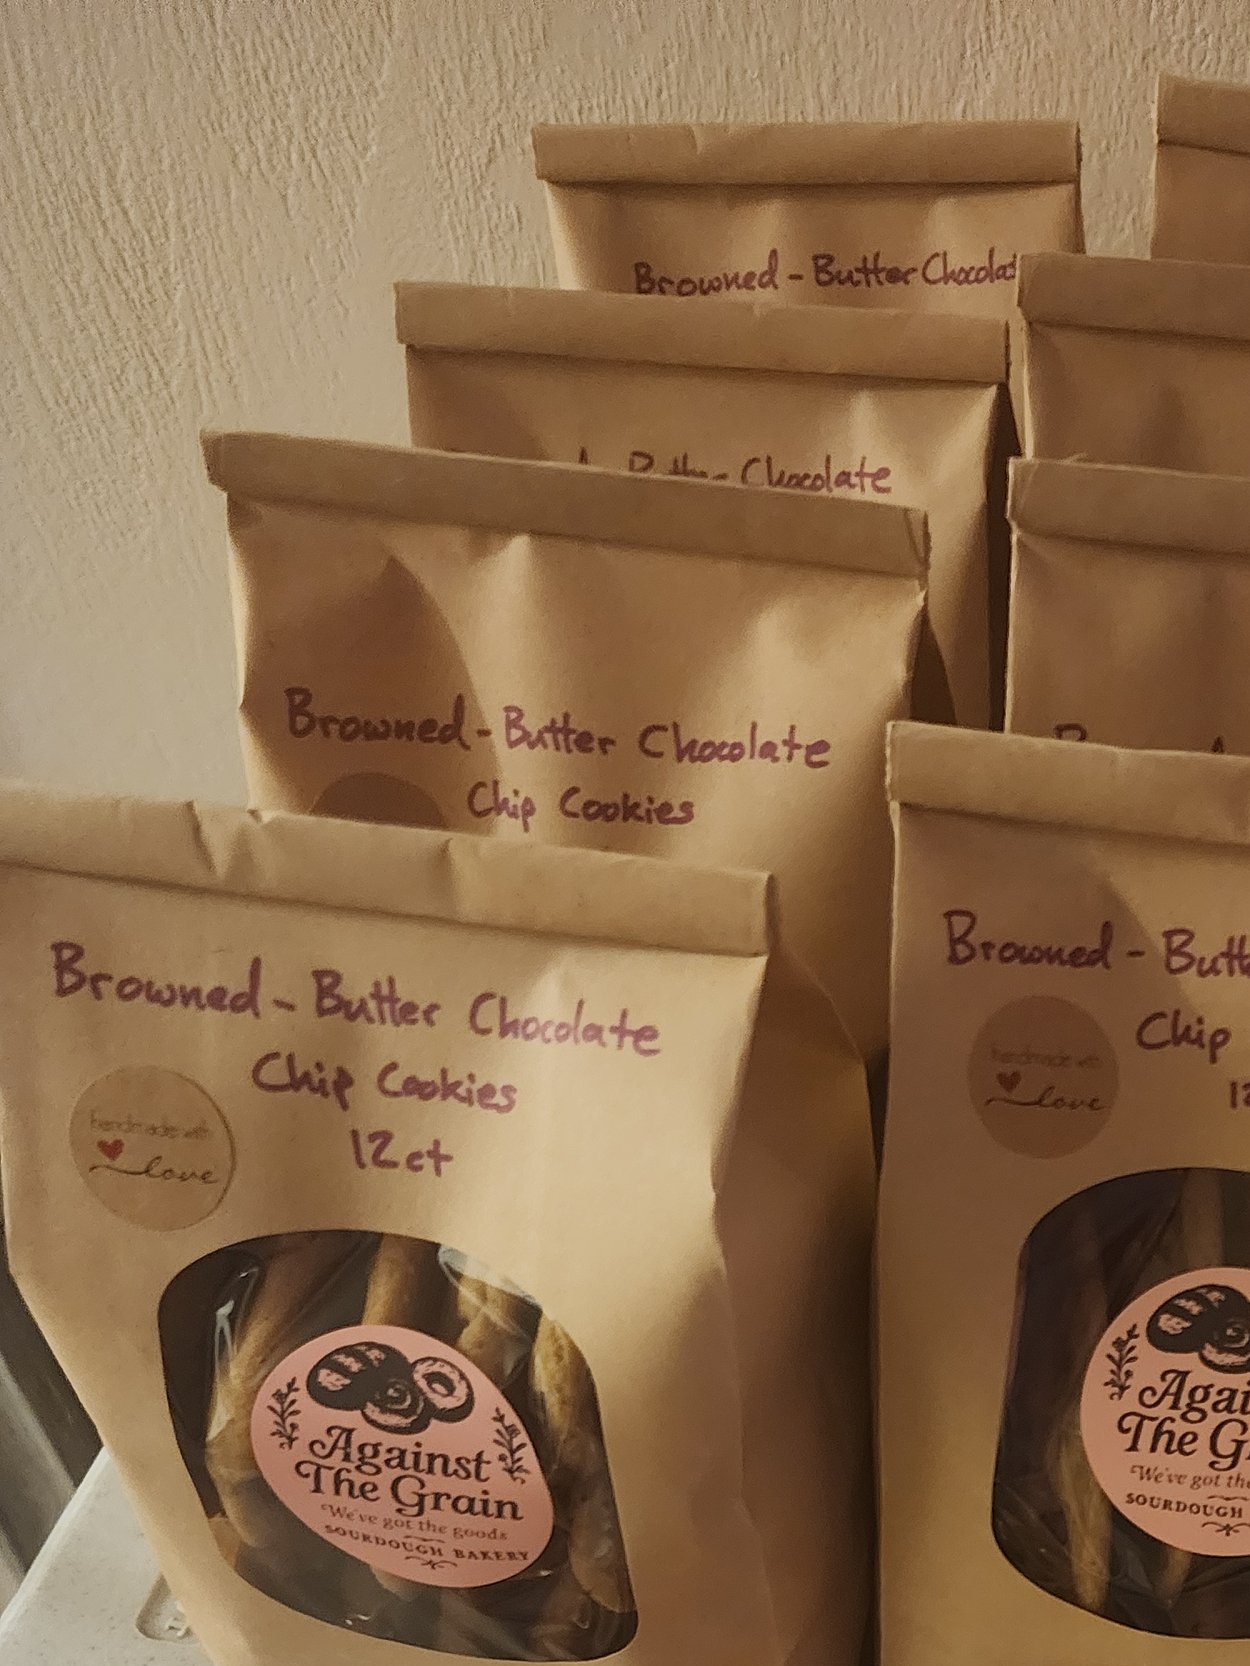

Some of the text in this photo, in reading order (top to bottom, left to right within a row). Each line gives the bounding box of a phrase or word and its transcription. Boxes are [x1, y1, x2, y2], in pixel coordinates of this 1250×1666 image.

[638, 721, 831, 768] Chocolate
[467, 780, 696, 832] Chip Cookies
[468, 990, 662, 1058] Chocolate
[1136, 1010, 1233, 1064] Chip
[250, 1051, 518, 1113] Chip Cookies
[309, 1424, 493, 1483] Against
[1117, 1411, 1199, 1457] The
[295, 1459, 525, 1522] The Grain
[1190, 1471, 1222, 1489] got
[383, 1517, 412, 1532] got
[418, 1518, 448, 1535] the
[453, 1523, 508, 1541] goods
[1125, 1492, 1244, 1519] SOURDOUGH
[324, 1524, 530, 1562] SOURDOUGH BAKERY
